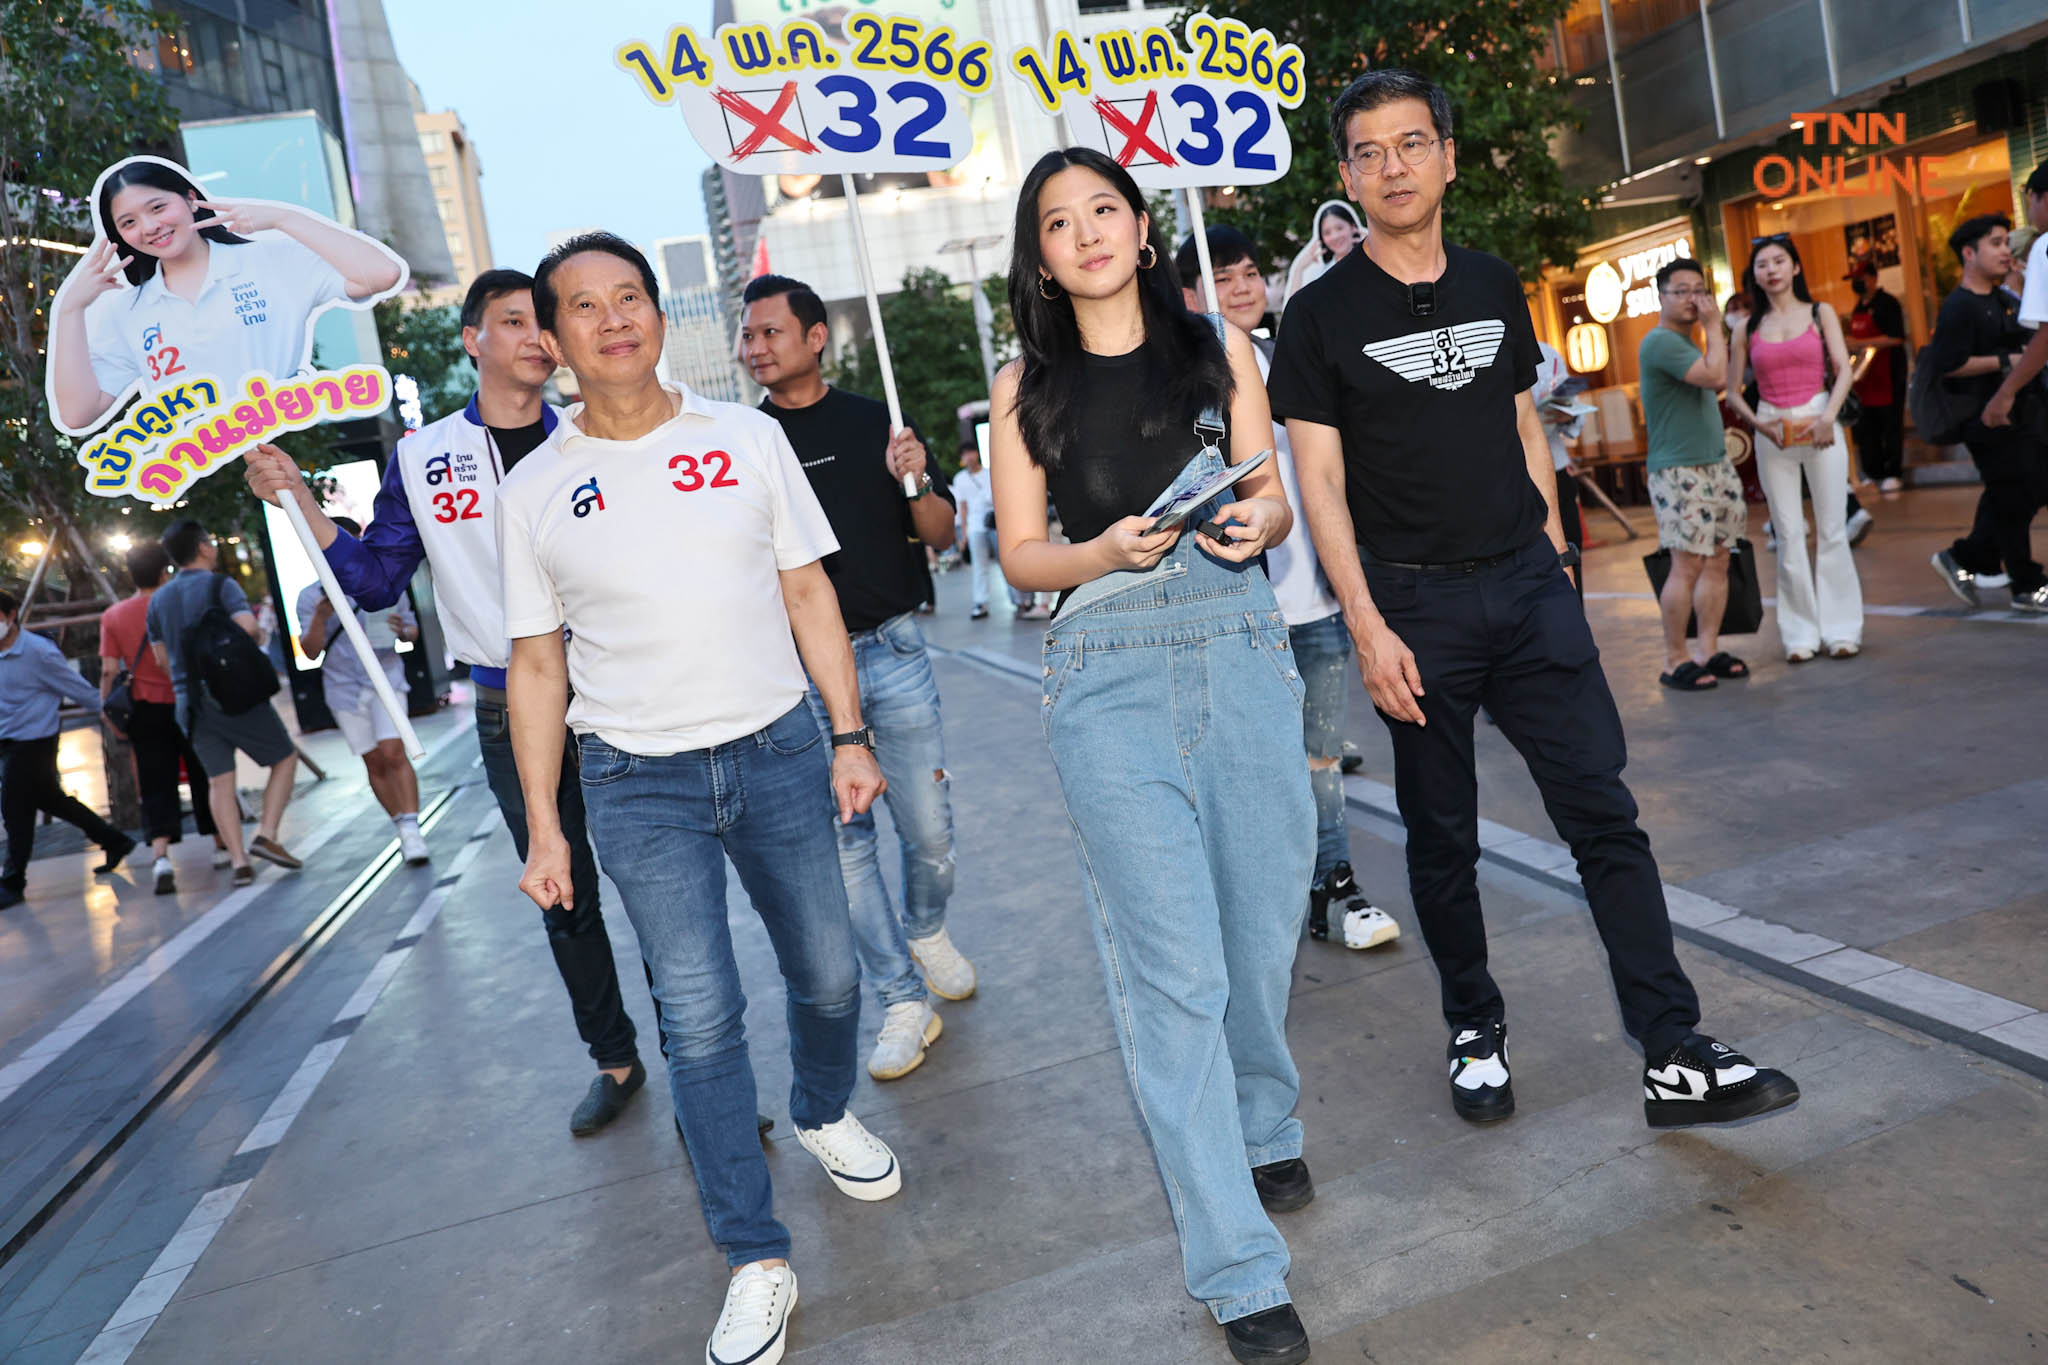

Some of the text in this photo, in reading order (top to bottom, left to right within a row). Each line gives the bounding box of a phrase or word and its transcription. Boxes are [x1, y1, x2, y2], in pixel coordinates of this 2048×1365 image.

[626, 19, 987, 94] 14 พ.ค. 2566
[1019, 25, 1298, 103] 14 พ.ค. 2566
[815, 74, 951, 158] 32
[1170, 84, 1277, 171] 32
[241, 312, 267, 326] ไทย
[146, 346, 186, 381] 32
[1432, 346, 1466, 374] 32
[89, 382, 216, 487] เข้าคูหา
[668, 450, 739, 492] 32
[432, 488, 483, 524] 32
